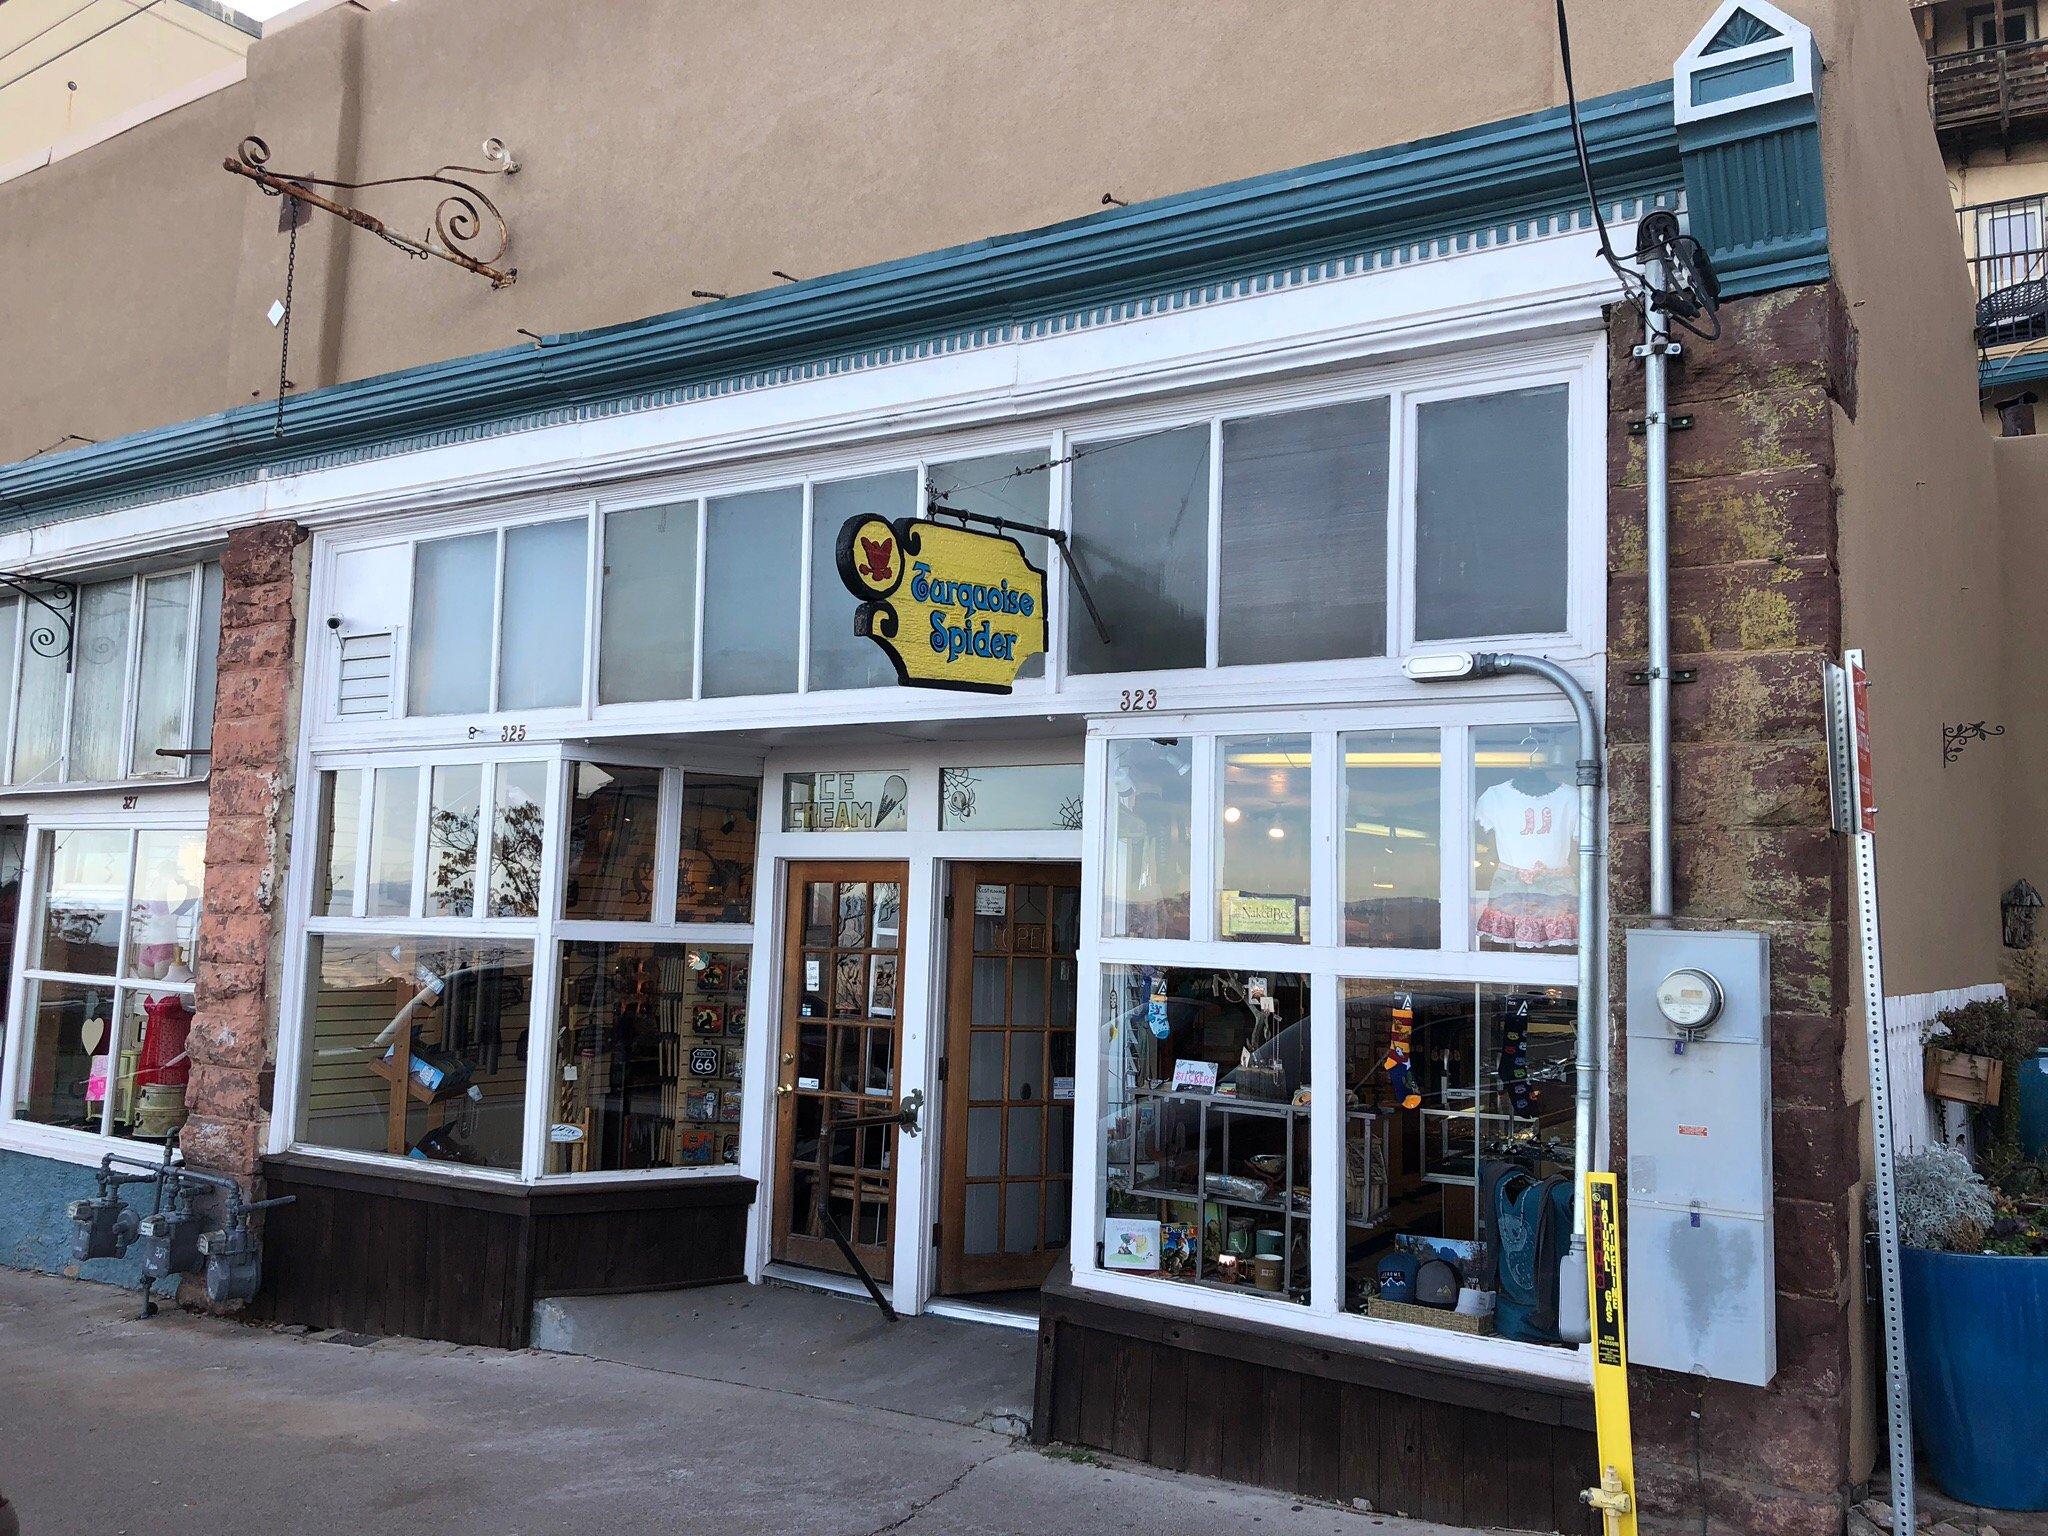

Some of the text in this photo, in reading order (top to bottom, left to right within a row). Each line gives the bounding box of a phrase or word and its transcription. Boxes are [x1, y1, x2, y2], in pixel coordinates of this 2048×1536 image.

[911, 561, 1035, 618] Turquoise
[929, 610, 1018, 663] Spider
[1120, 688, 1158, 711] 323
[501, 724, 527, 742] 325
[122, 795, 139, 810] 327
[789, 801, 872, 828] CREAM
[695, 1058, 712, 1071] 66
[1600, 1199, 1611, 1272] NATURAL
[1608, 1222, 1619, 1310] PIPELINE
[1604, 1290, 1614, 1323] GAS
